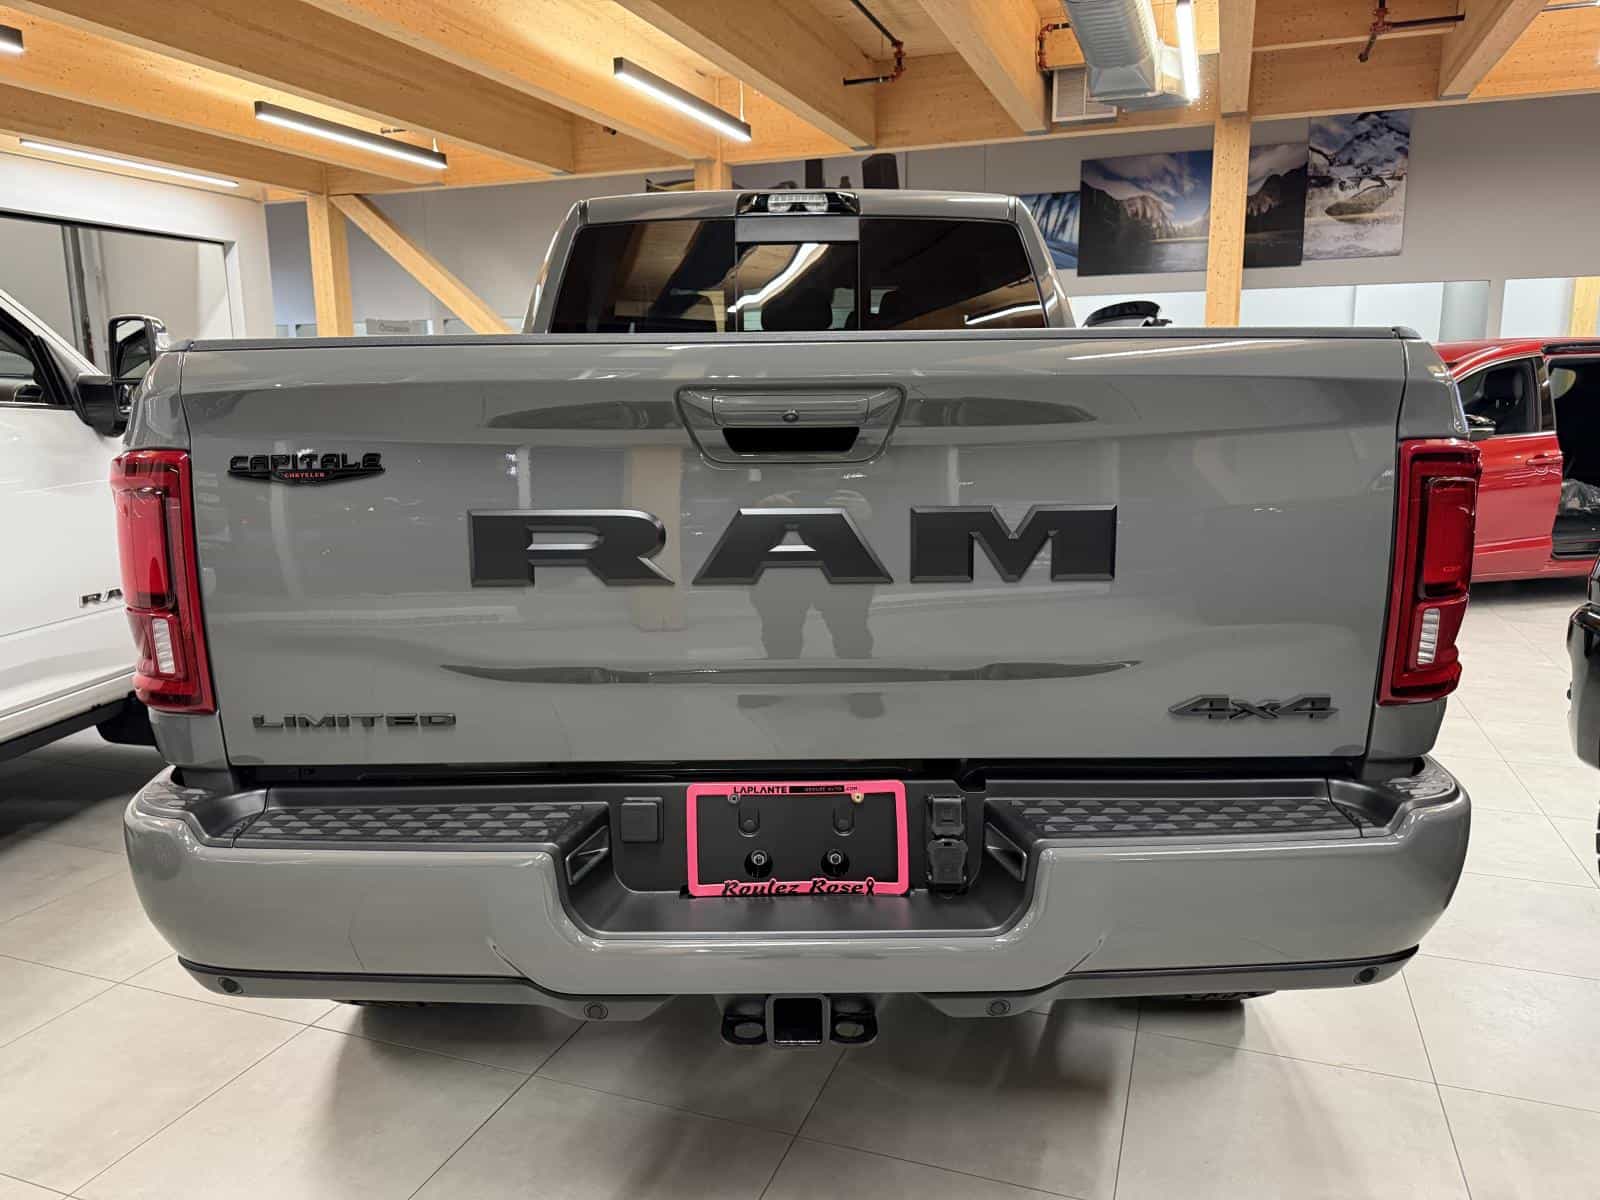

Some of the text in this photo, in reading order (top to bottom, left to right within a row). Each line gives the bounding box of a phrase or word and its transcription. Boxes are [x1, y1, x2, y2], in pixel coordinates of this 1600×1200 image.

[229, 452, 384, 471] CAPITALE
[467, 504, 1117, 587] RAM
[80, 588, 122, 607] RA
[251, 713, 456, 729] LIMITED
[733, 785, 788, 794] LAPLANTE
[721, 878, 863, 897] Roulez Rose
